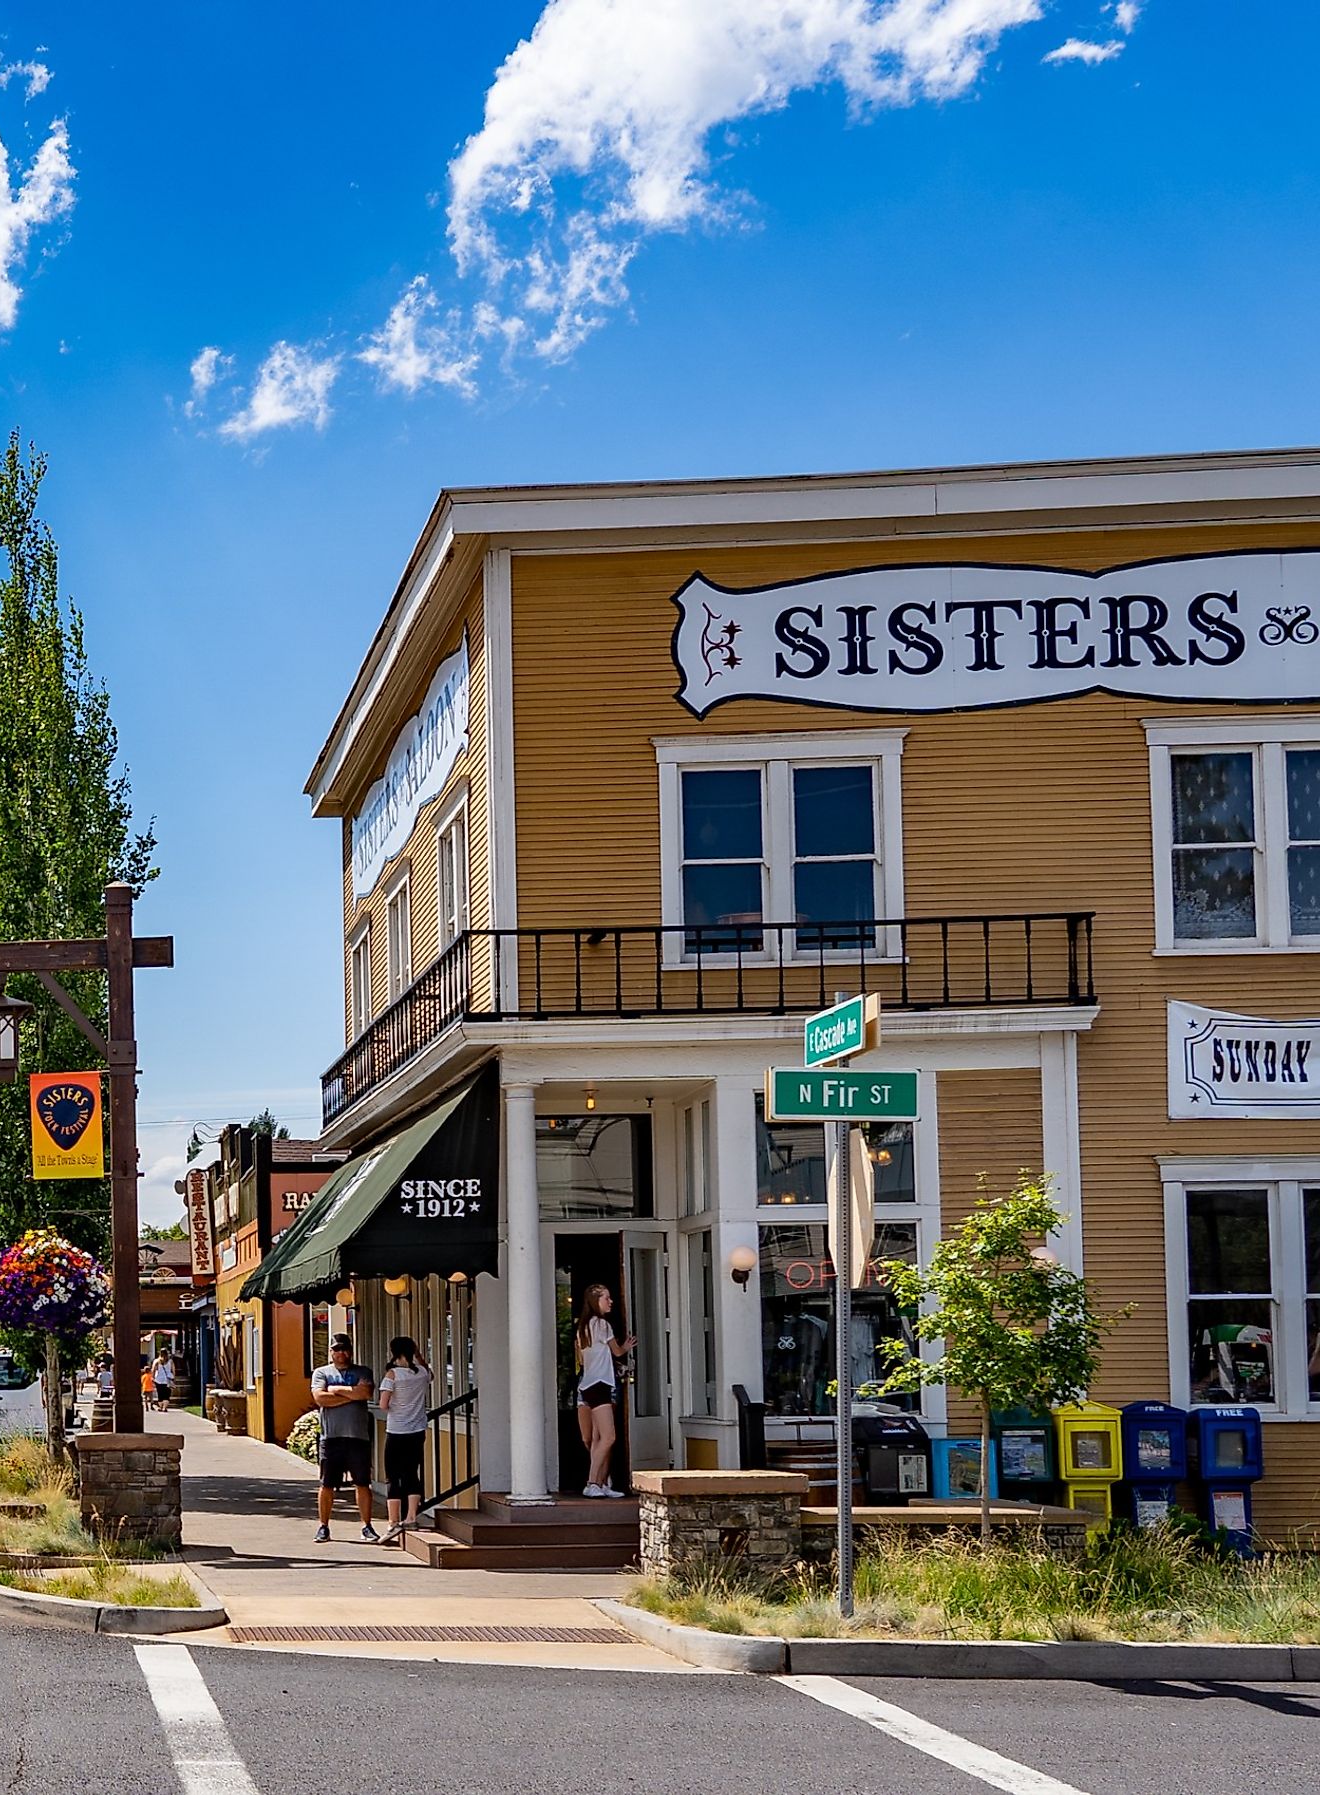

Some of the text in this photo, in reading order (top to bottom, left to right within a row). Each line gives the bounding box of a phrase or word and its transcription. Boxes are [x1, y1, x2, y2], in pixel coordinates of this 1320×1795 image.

[774, 588, 1247, 680] SISTERS
[356, 671, 456, 878] SISTERS SALOON
[809, 1017, 857, 1054] E Cascade Ave
[1212, 1037, 1312, 1083] SUNDAY
[43, 1087, 89, 1107] SISTERS
[799, 1080, 892, 1107] N Fir ST
[43, 1110, 59, 1132] FOLK
[60, 1108, 89, 1135] FESTIVAL
[285, 1192, 318, 1209] RA
[400, 1179, 481, 1199] SINCE
[190, 1172, 210, 1271] RESTAURANT
[415, 1199, 465, 1218] 1912
[786, 1260, 888, 1290] OPN
[1215, 1408, 1244, 1417] FREE
